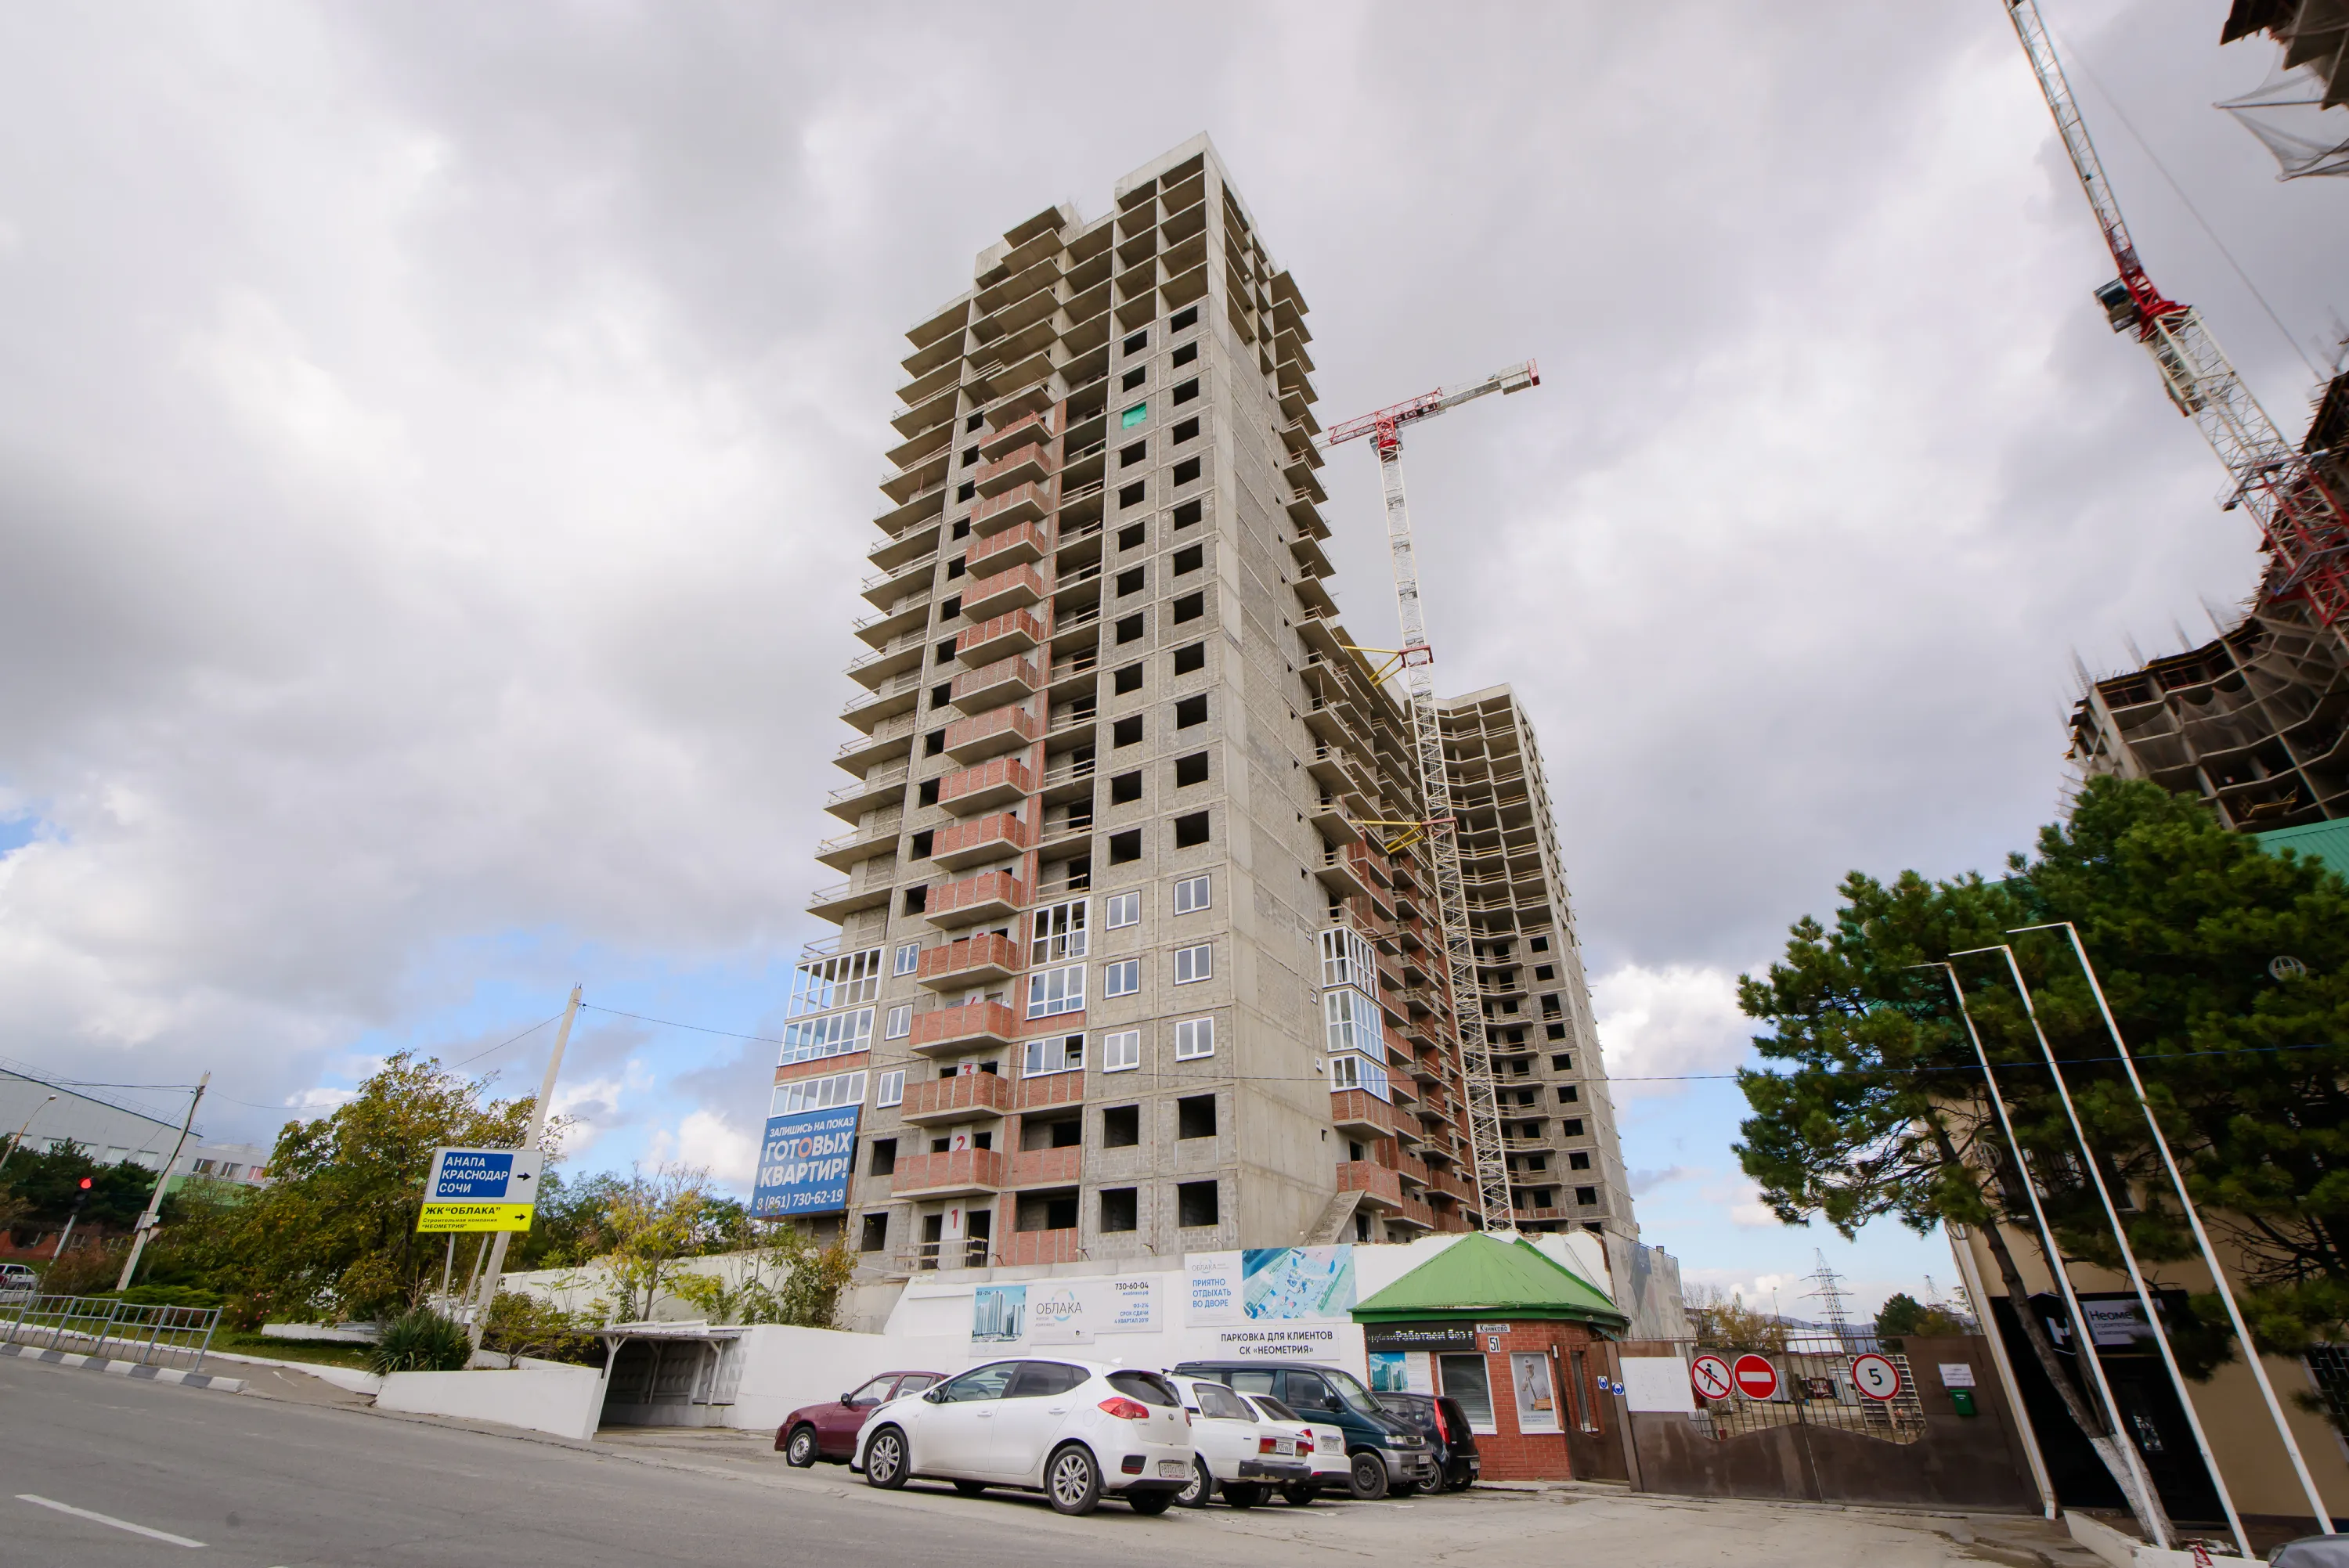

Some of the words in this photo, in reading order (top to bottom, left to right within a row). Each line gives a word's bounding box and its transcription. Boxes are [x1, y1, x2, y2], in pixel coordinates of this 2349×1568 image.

[769, 1123, 813, 1137] ЗАПИШИСЬ
[814, 1121, 825, 1131] НА
[826, 1116, 854, 1130] ПОКАЗ
[764, 1131, 853, 1162] ГОТОВЫХ
[445, 1156, 485, 1167] АНАПА
[442, 1170, 508, 1181] КРАСНОДАР
[760, 1157, 849, 1188] КВАРТИР!
[438, 1183, 471, 1193] СОЧИ
[756, 1197, 763, 1210] 8
[765, 1193, 791, 1211] (861)
[792, 1188, 843, 1207] 730-62-19
[951, 1209, 958, 1229] 1
[1115, 1281, 1149, 1291] 730-60-04
[1193, 1278, 1226, 1287] ПРИЯТНО
[1193, 1289, 1232, 1298] ОТДЫХАТЬ
[1036, 1302, 1083, 1314] ОБЛАКА
[1204, 1299, 1229, 1309] ДВОРЕ
[2088, 1310, 2134, 1321] Неоме
[1479, 1324, 1508, 1332] Куникова
[1221, 1332, 1265, 1342] ПАРКОВКА
[1268, 1332, 1285, 1342] ДЛЯ
[1286, 1331, 1333, 1340] КЛИЕНТОВ
[1239, 1346, 1250, 1354] СК
[1253, 1345, 1314, 1354] «НЕОМЕТРИЯ»
[1489, 1337, 1499, 1351] 51
[1867, 1368, 1883, 1386] 5
